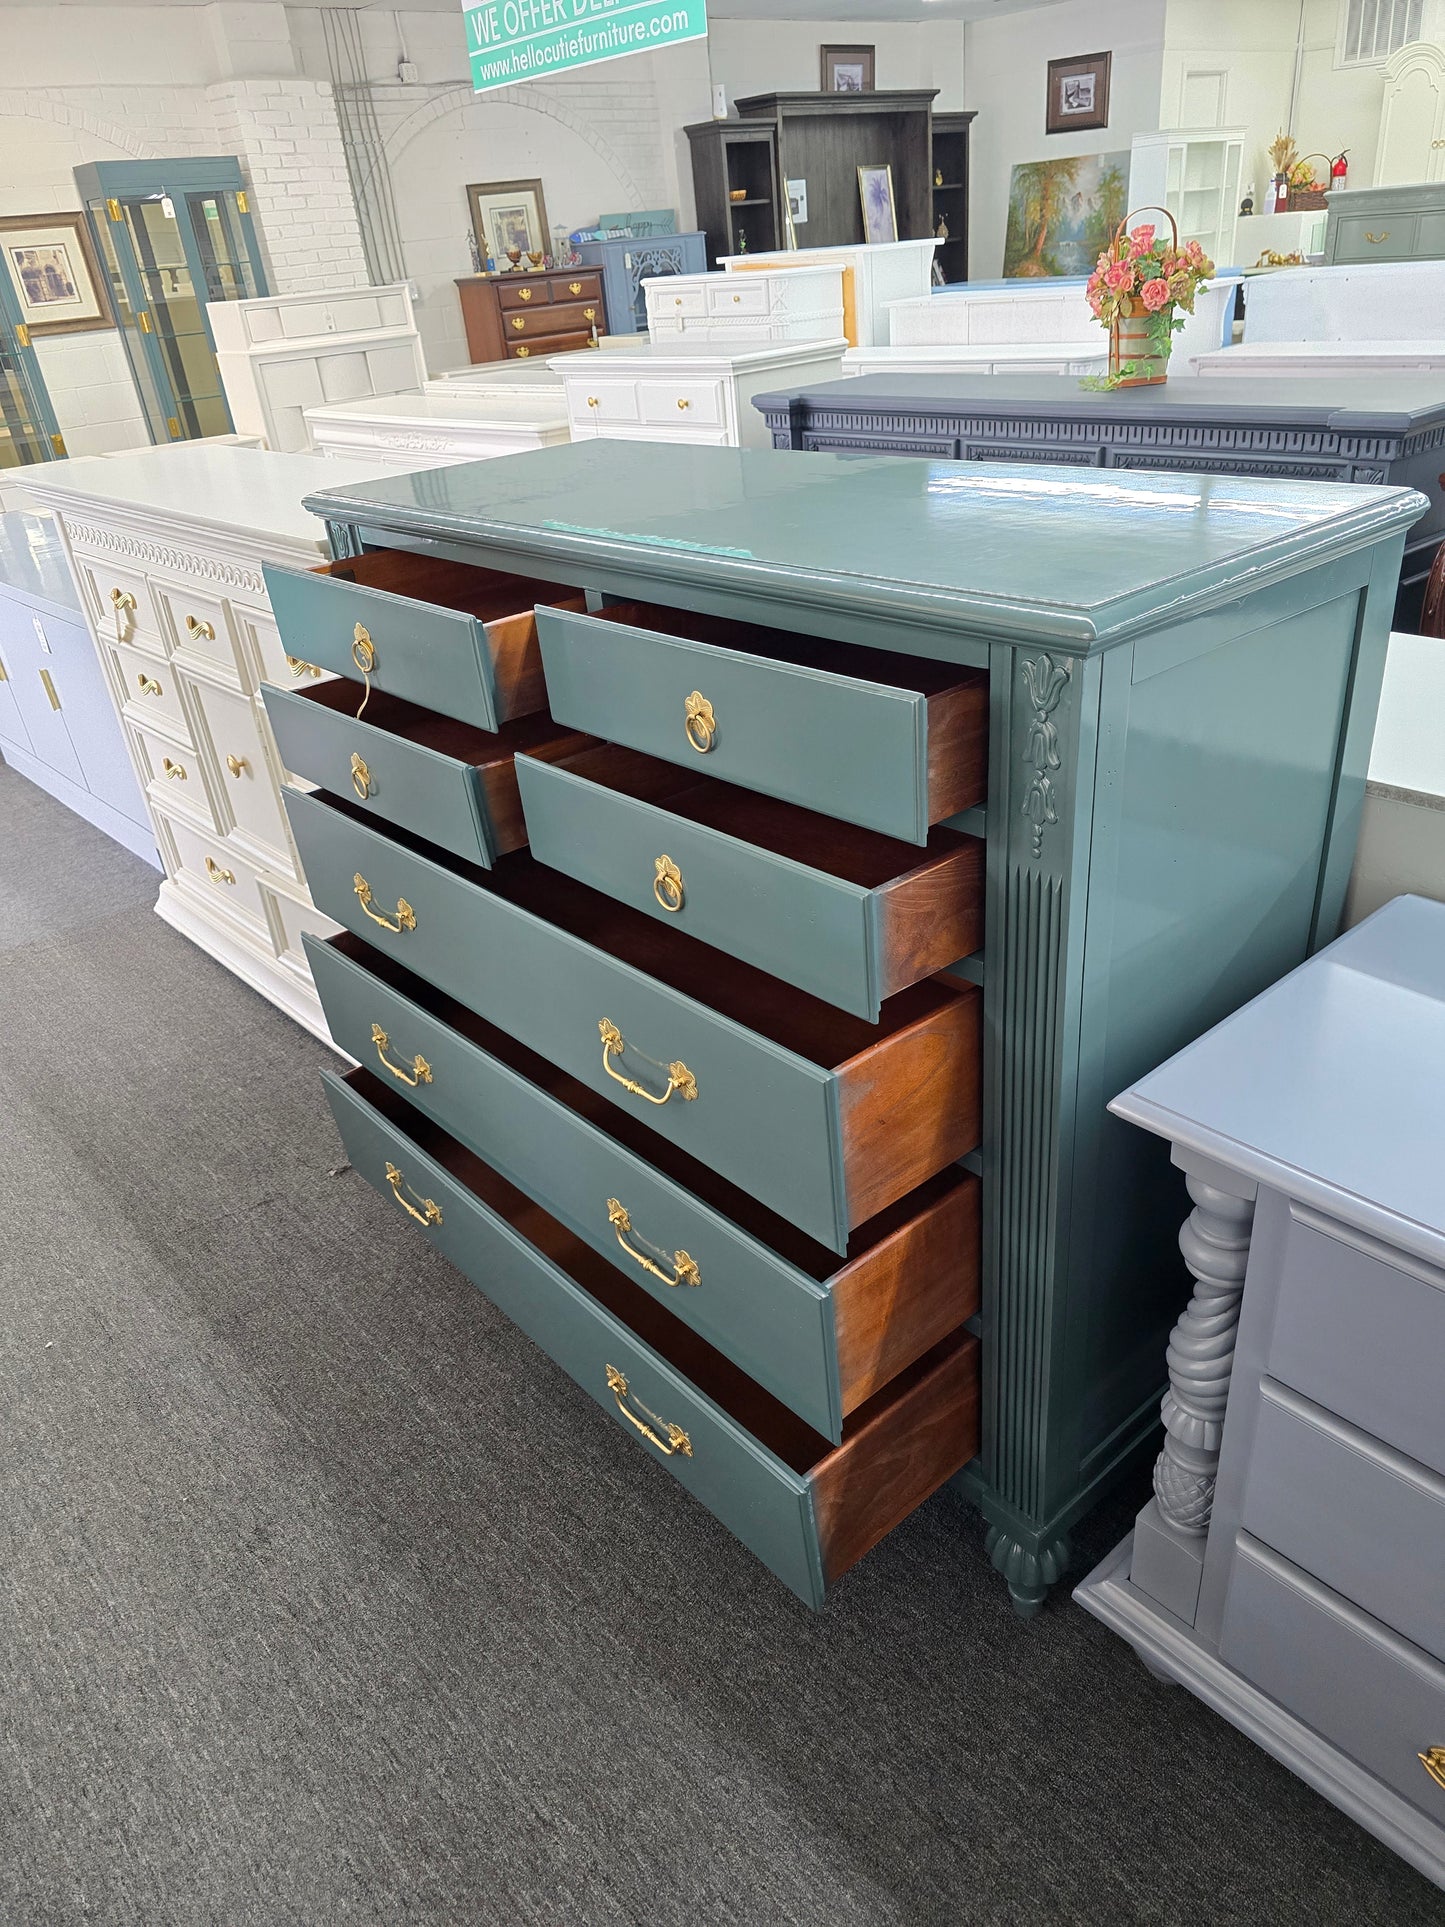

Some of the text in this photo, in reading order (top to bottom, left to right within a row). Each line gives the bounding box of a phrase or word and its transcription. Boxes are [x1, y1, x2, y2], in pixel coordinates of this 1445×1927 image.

[471, 7, 501, 46] WE
[503, 0, 567, 36] OFFER
[480, 10, 689, 81] www.hellocutiefurniture.com
